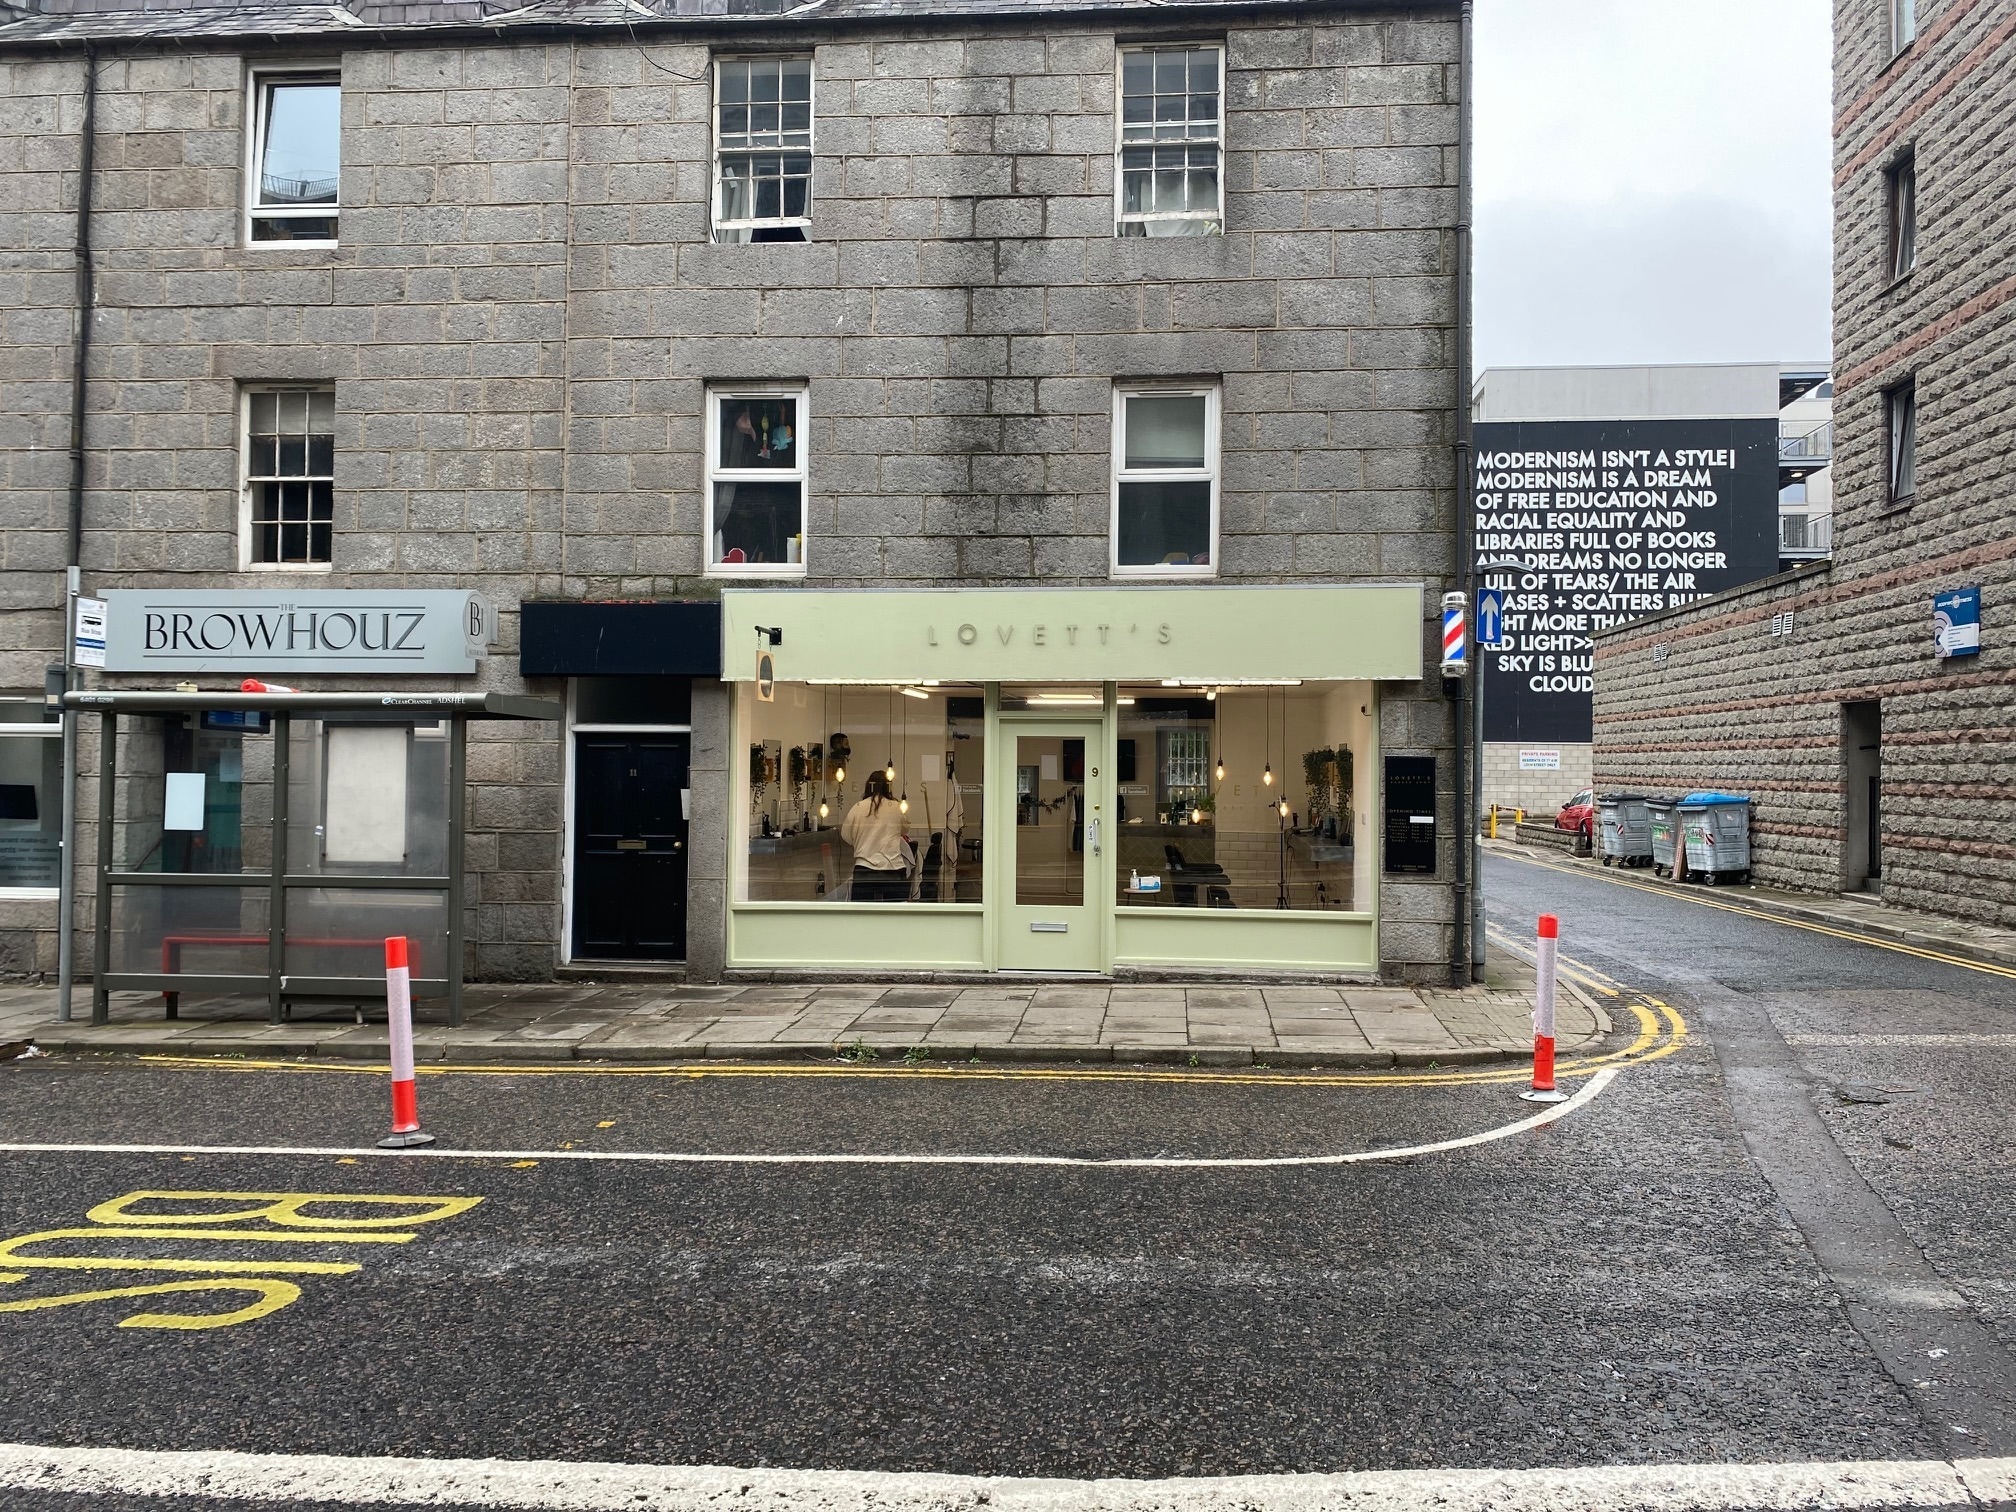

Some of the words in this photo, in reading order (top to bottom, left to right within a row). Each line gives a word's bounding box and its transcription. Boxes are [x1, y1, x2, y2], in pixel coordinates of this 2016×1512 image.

[1476, 450, 1596, 470] MODERNISM
[1602, 450, 1650, 469] ISN'T
[1654, 450, 1670, 467] A
[1476, 470, 1596, 490] MODERNISM
[1602, 471, 1619, 487] IS
[1623, 470, 1639, 487] A
[1644, 469, 1712, 487] DREAM
[1476, 493, 1503, 510] OF
[1508, 493, 1549, 509] FREE
[1555, 490, 1667, 509] EDUCATION
[1672, 489, 1718, 508] AND
[1476, 512, 1541, 530] RACIAL
[1547, 511, 1637, 530] EQUALITY
[1641, 510, 1686, 529] AND
[1476, 533, 1564, 550] LIBRARIES
[1570, 533, 1610, 550] FULL
[1615, 532, 1643, 549] OF
[1648, 531, 1716, 549] BOOKS
[1525, 552, 1603, 571] DREAMS
[1609, 553, 1642, 570] NO
[1648, 551, 1727, 570] LONGER
[1485, 574, 1517, 590] ULL
[1521, 573, 1548, 590] OF
[1552, 572, 1620, 594] TEARS/
[1624, 573, 1658, 590] THE
[1663, 572, 1696, 590] AIR
[280, 603, 296, 612] THE
[1502, 593, 1549, 611] ASES
[1572, 592, 1663, 611] SCATTERS
[143, 612, 426, 650] BROWHOUZ
[1531, 613, 1587, 631] MORE
[928, 623, 1172, 646] LOVETT'S
[1498, 655, 1533, 673] SKY
[1539, 655, 1556, 672] IS
[1561, 655, 1593, 672] BLU
[1529, 675, 1594, 693] CLOUD
[1091, 767, 1099, 777] 9
[0, 1190, 485, 1330] BUS
